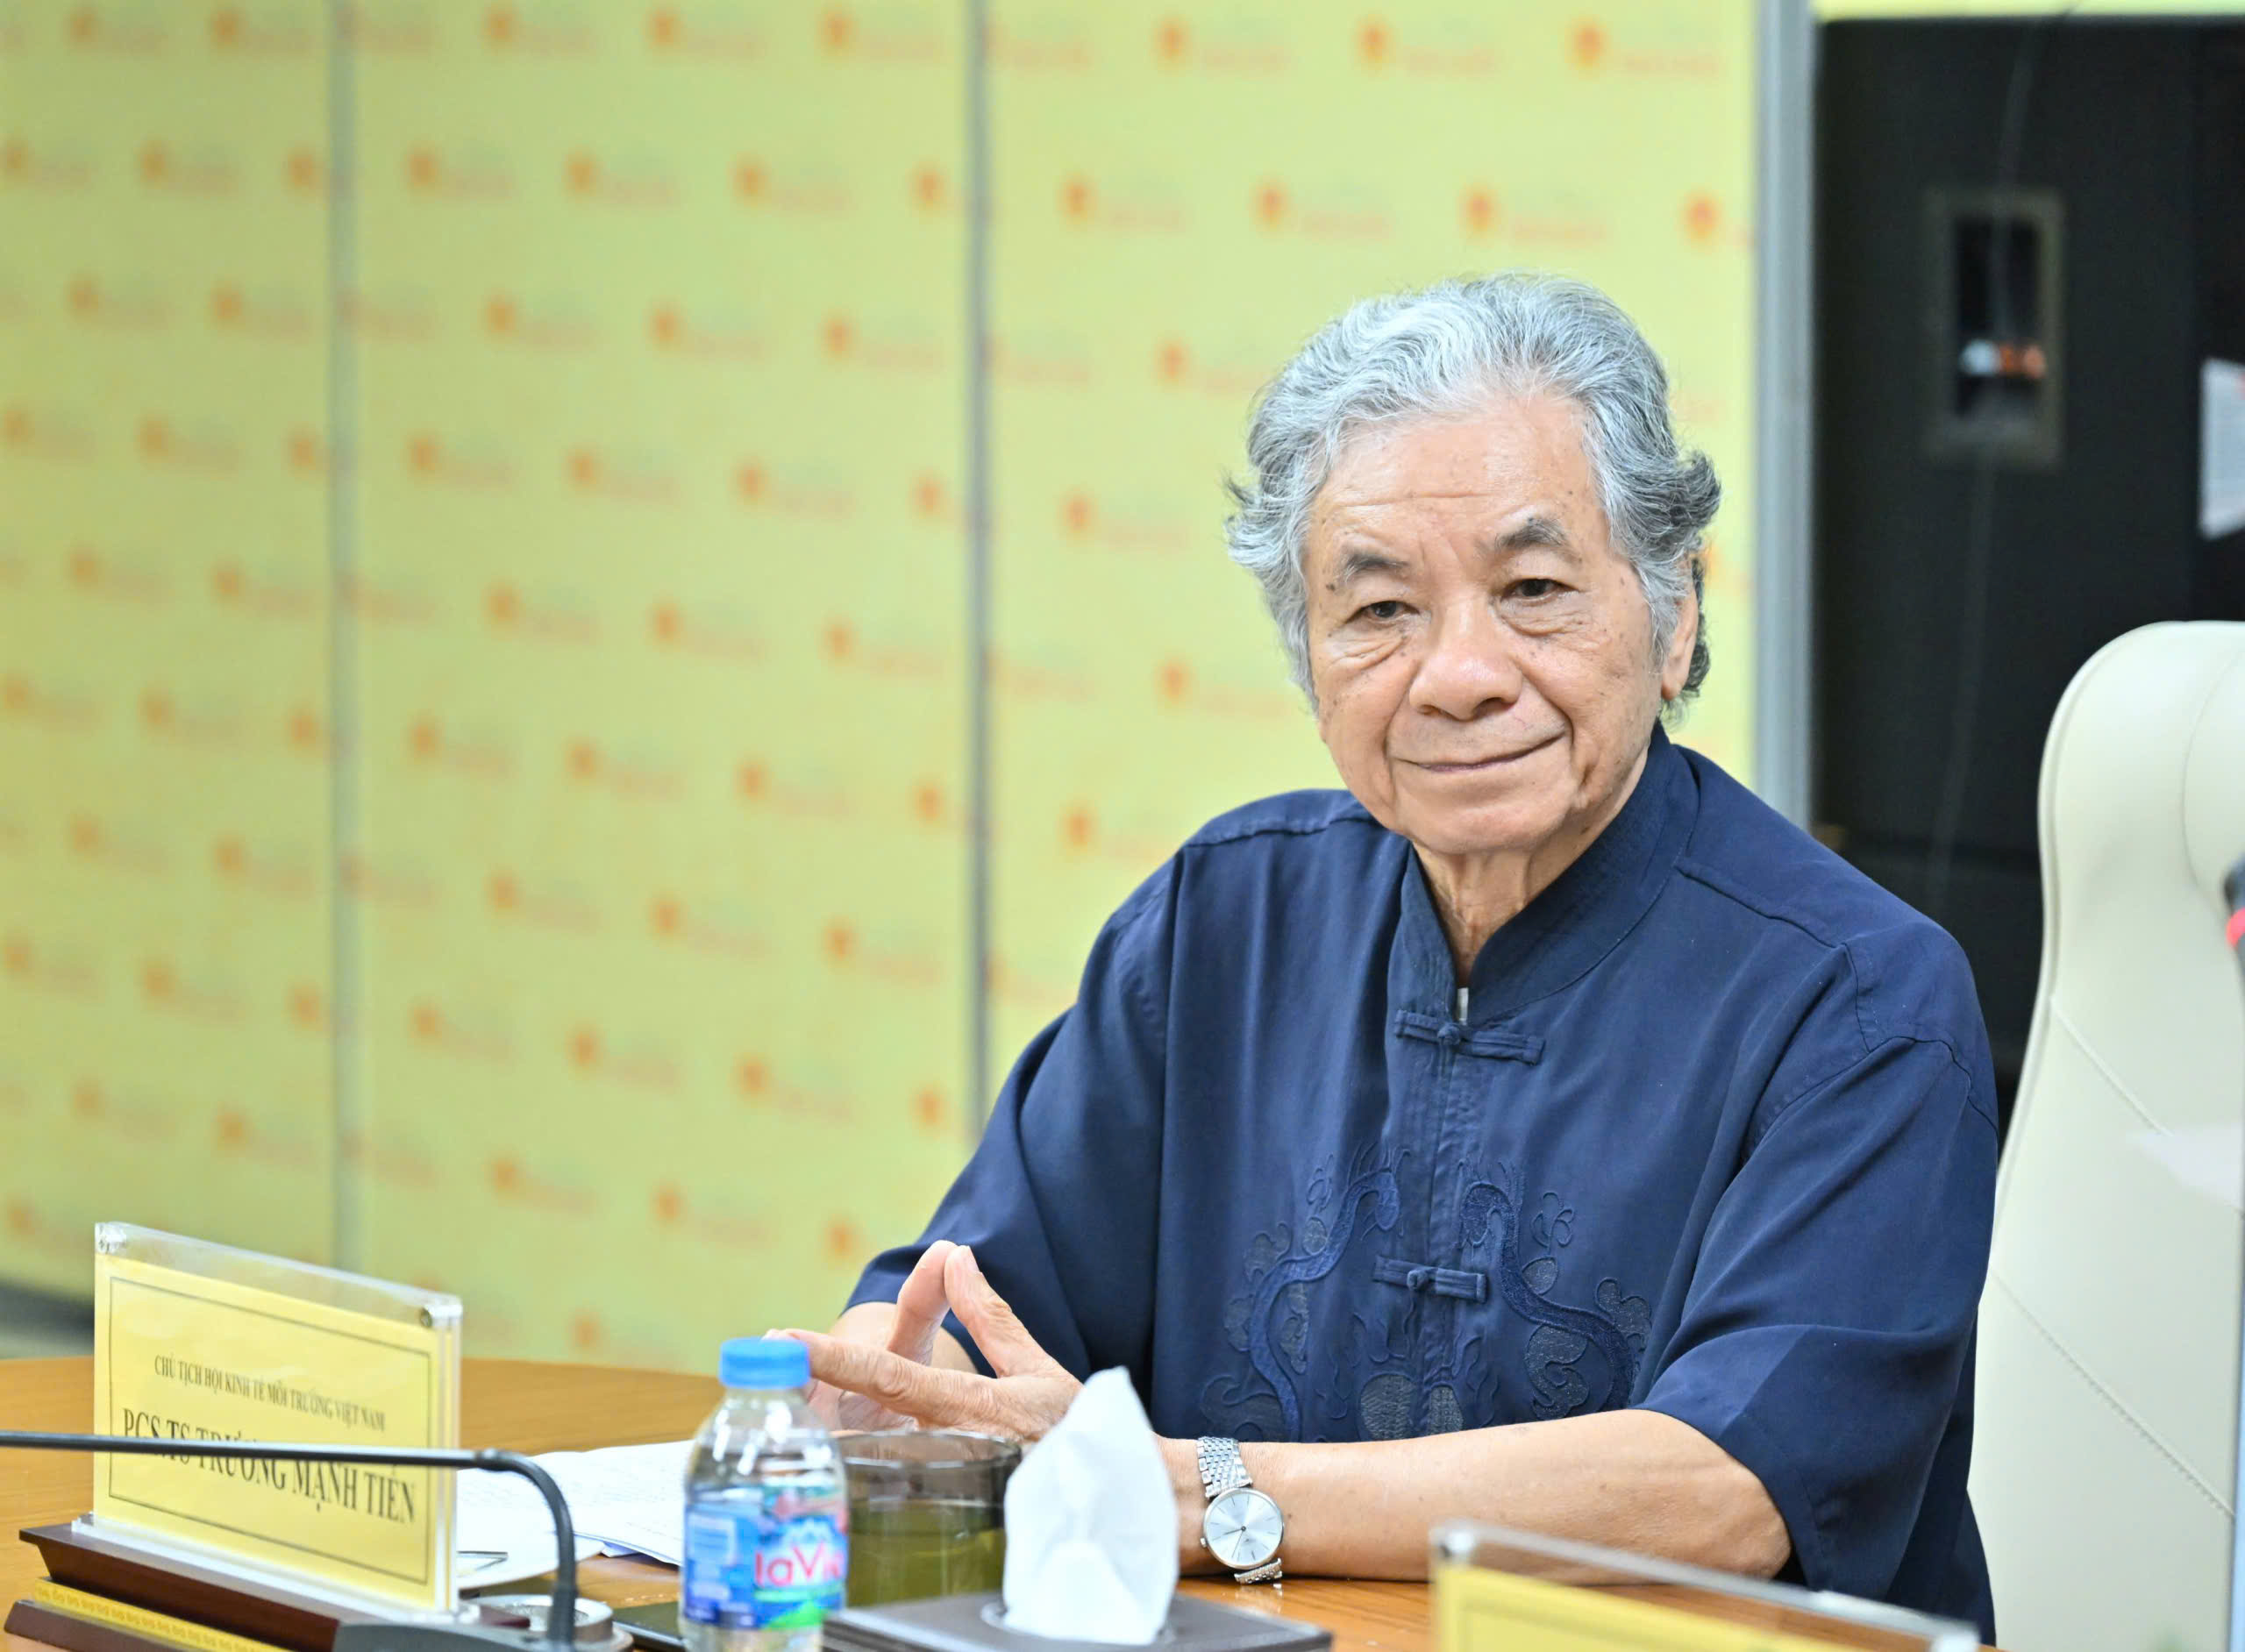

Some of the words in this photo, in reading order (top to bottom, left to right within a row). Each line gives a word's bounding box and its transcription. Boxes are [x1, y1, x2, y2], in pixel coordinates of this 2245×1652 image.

[178, 1360, 202, 1387] TỊCH
[225, 1372, 249, 1399] KINH
[360, 1406, 385, 1432] NAM
